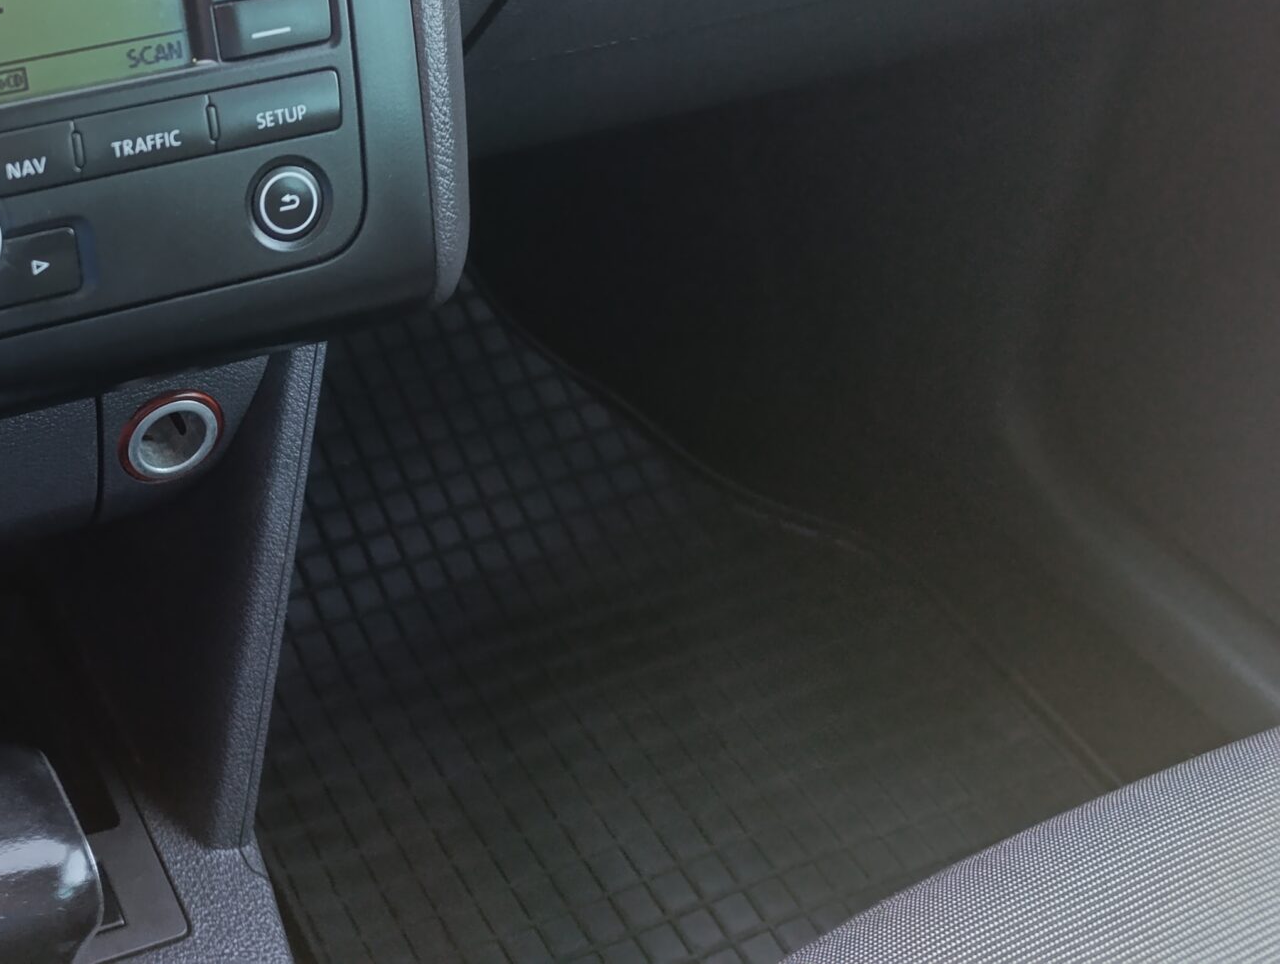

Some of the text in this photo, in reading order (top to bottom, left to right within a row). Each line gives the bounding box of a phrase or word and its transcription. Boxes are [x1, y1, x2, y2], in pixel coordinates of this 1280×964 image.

[126, 40, 184, 69] SCAN
[255, 104, 308, 130] SETUP
[110, 129, 182, 158] TRAFFIC
[5, 157, 48, 181] NAV
